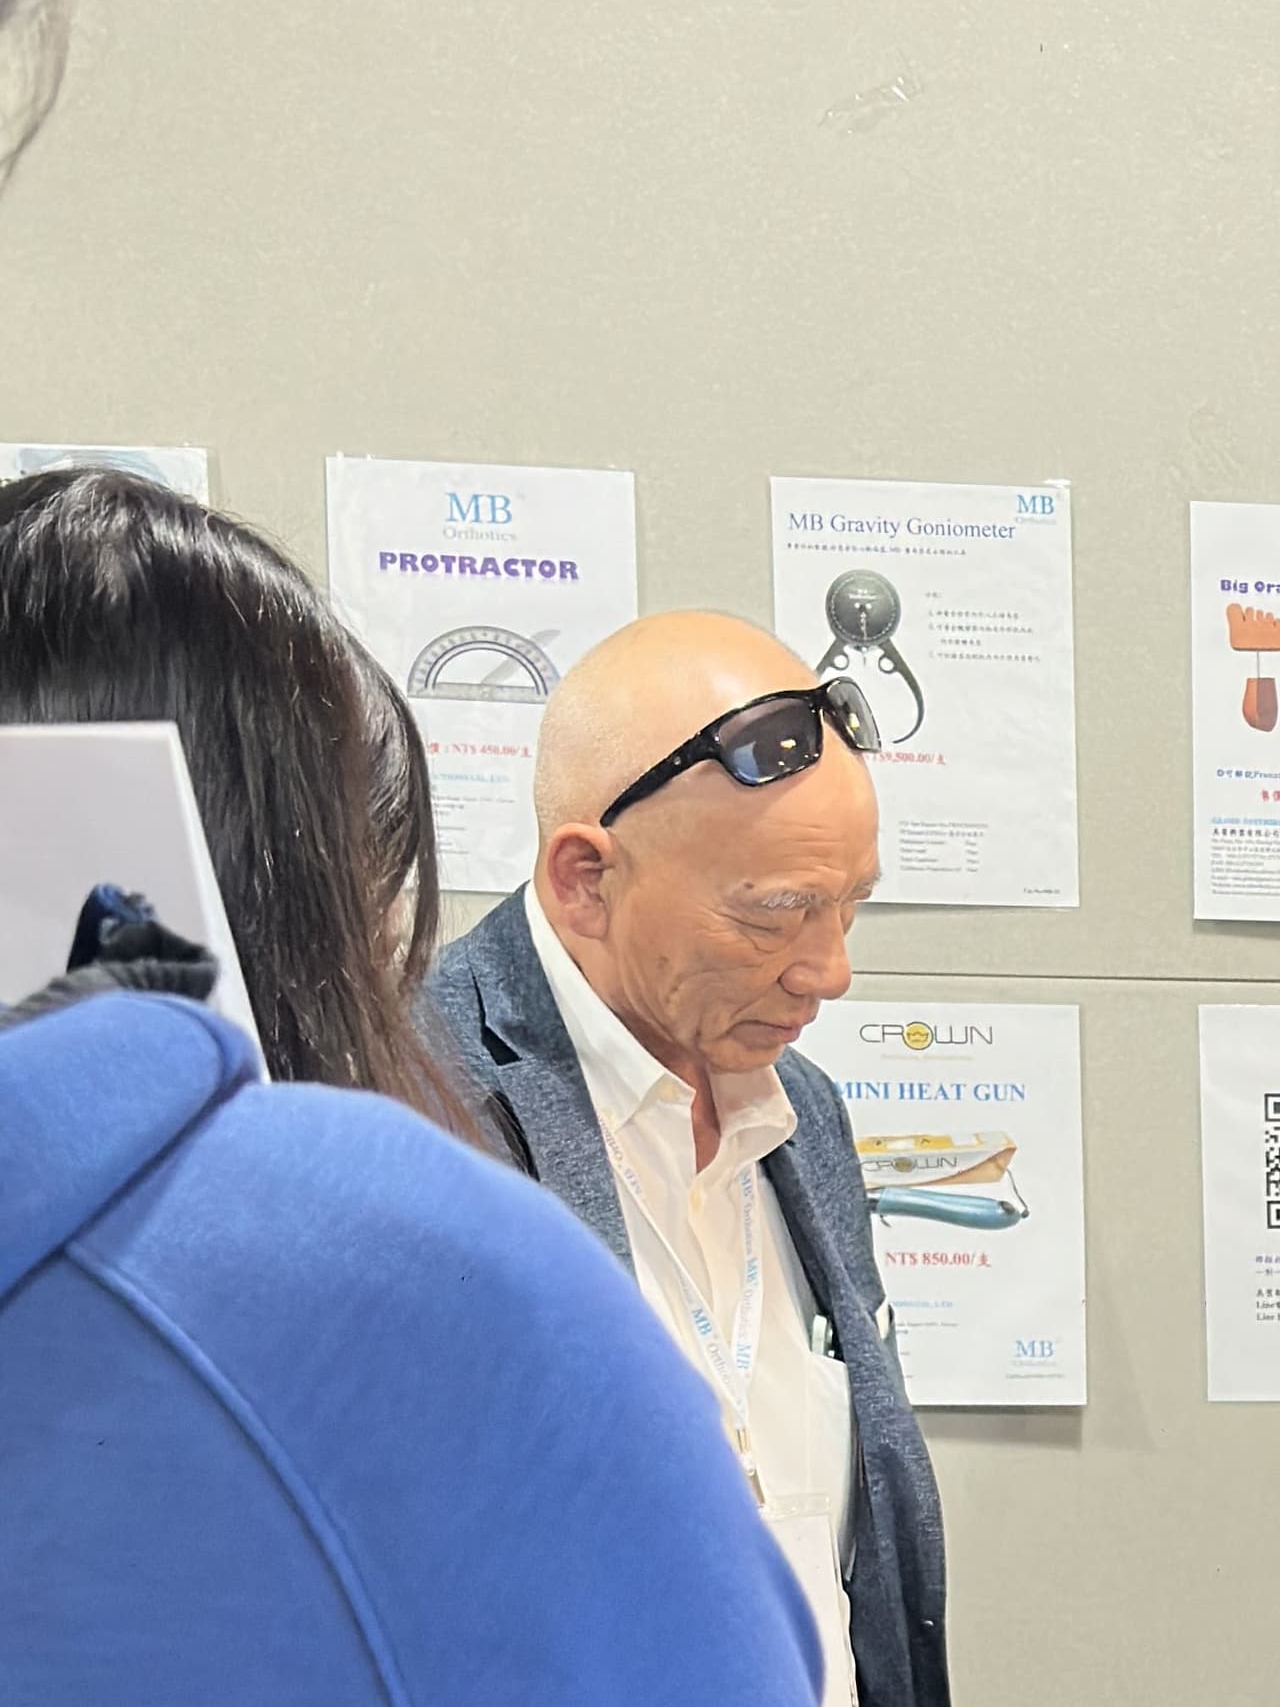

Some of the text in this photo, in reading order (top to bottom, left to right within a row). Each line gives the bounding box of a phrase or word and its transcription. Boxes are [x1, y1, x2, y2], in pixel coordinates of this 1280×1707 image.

[446, 492, 512, 524] MB
[1017, 494, 1054, 515] MB
[443, 526, 518, 541] Orthotics
[788, 512, 1016, 539] MB Gravity Goniometer
[379, 551, 579, 580] PROTRACTOR
[1220, 579, 1249, 593] Big
[859, 1021, 993, 1050] CROWN
[834, 1081, 1026, 1102] MINI HEAT GUN
[885, 1252, 918, 1265] NT$
[1015, 1340, 1054, 1358] MB
